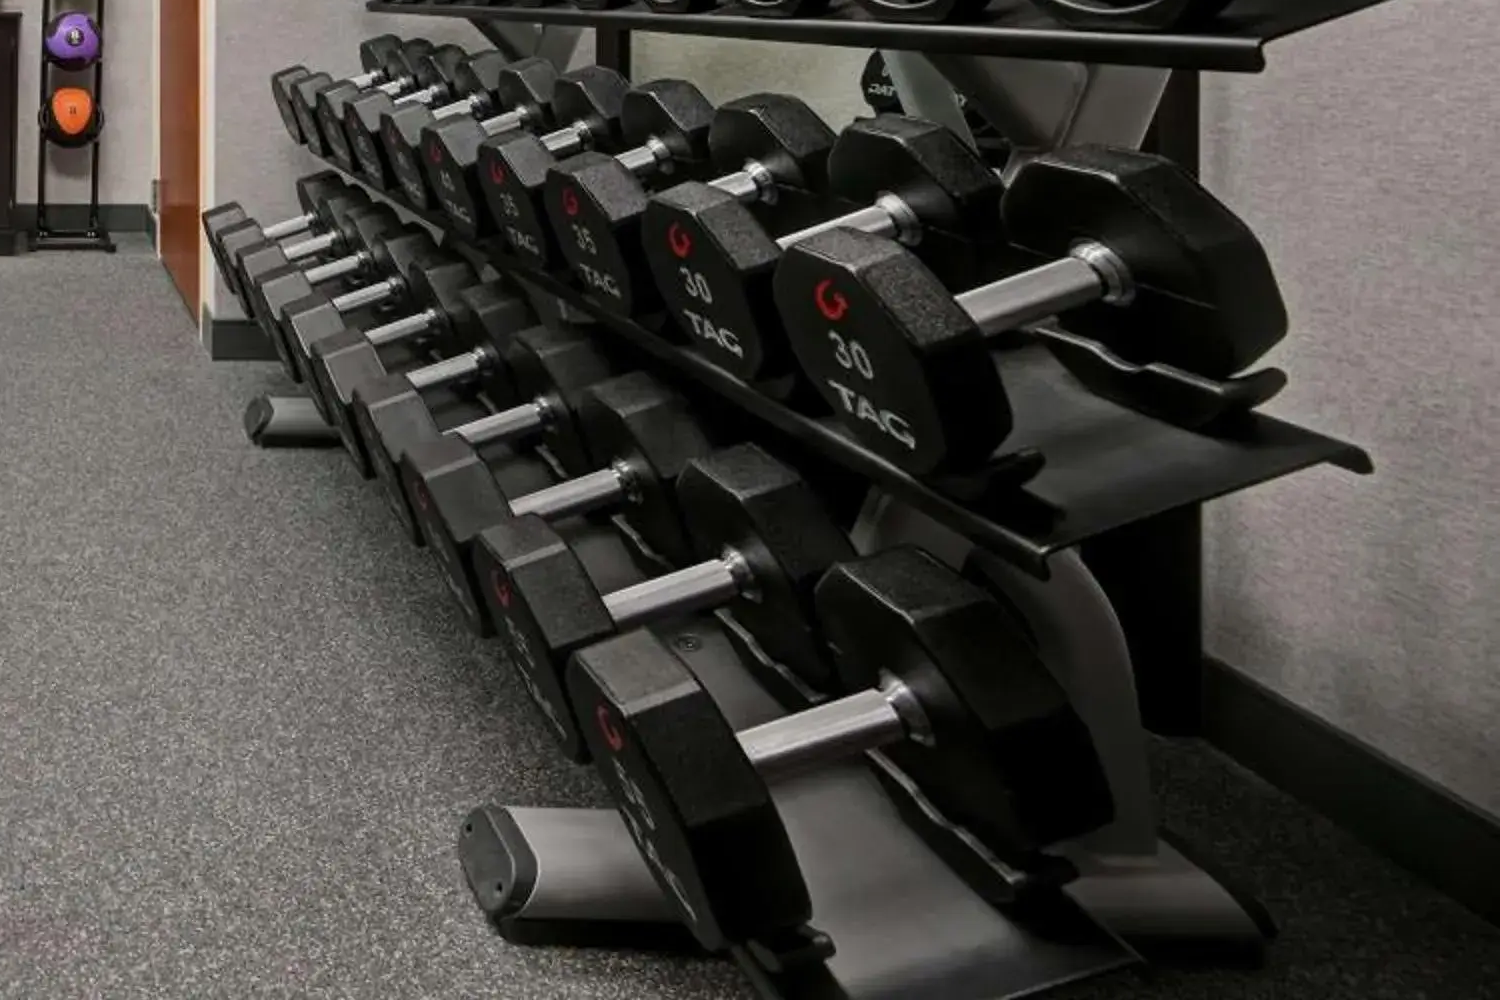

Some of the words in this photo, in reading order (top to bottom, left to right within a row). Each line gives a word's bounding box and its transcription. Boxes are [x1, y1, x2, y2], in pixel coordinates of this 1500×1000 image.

[579, 262, 622, 299] TAG
[679, 266, 713, 304] 30
[683, 308, 744, 359] TAG
[828, 329, 874, 380] 30
[827, 378, 916, 450] TAG
